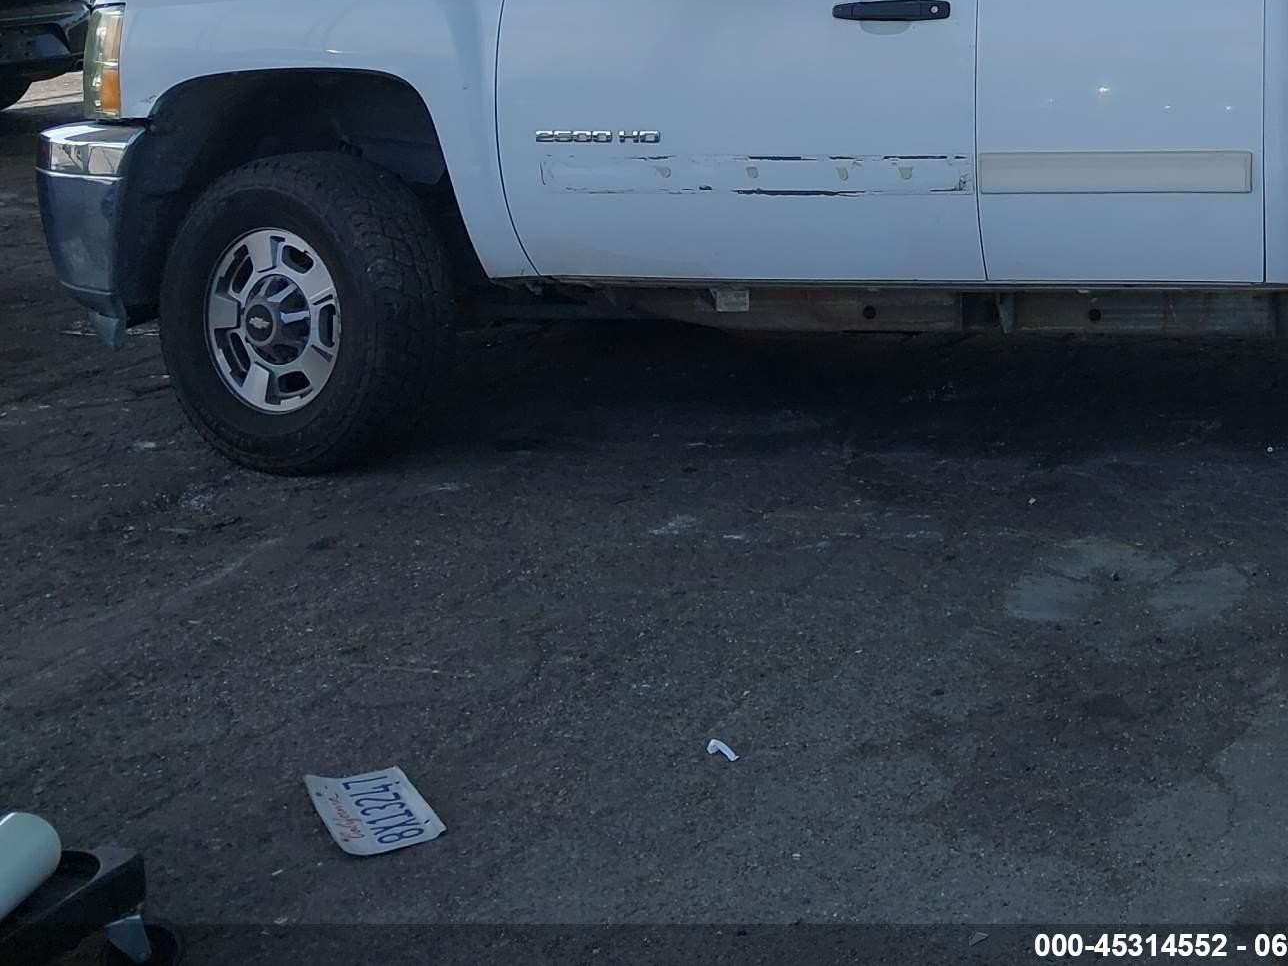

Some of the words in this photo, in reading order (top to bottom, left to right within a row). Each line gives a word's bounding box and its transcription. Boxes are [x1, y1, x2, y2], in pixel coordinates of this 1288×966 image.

[535, 130, 612, 143] 2500
[619, 130, 660, 143] HD
[341, 775, 424, 844] 8X13247
